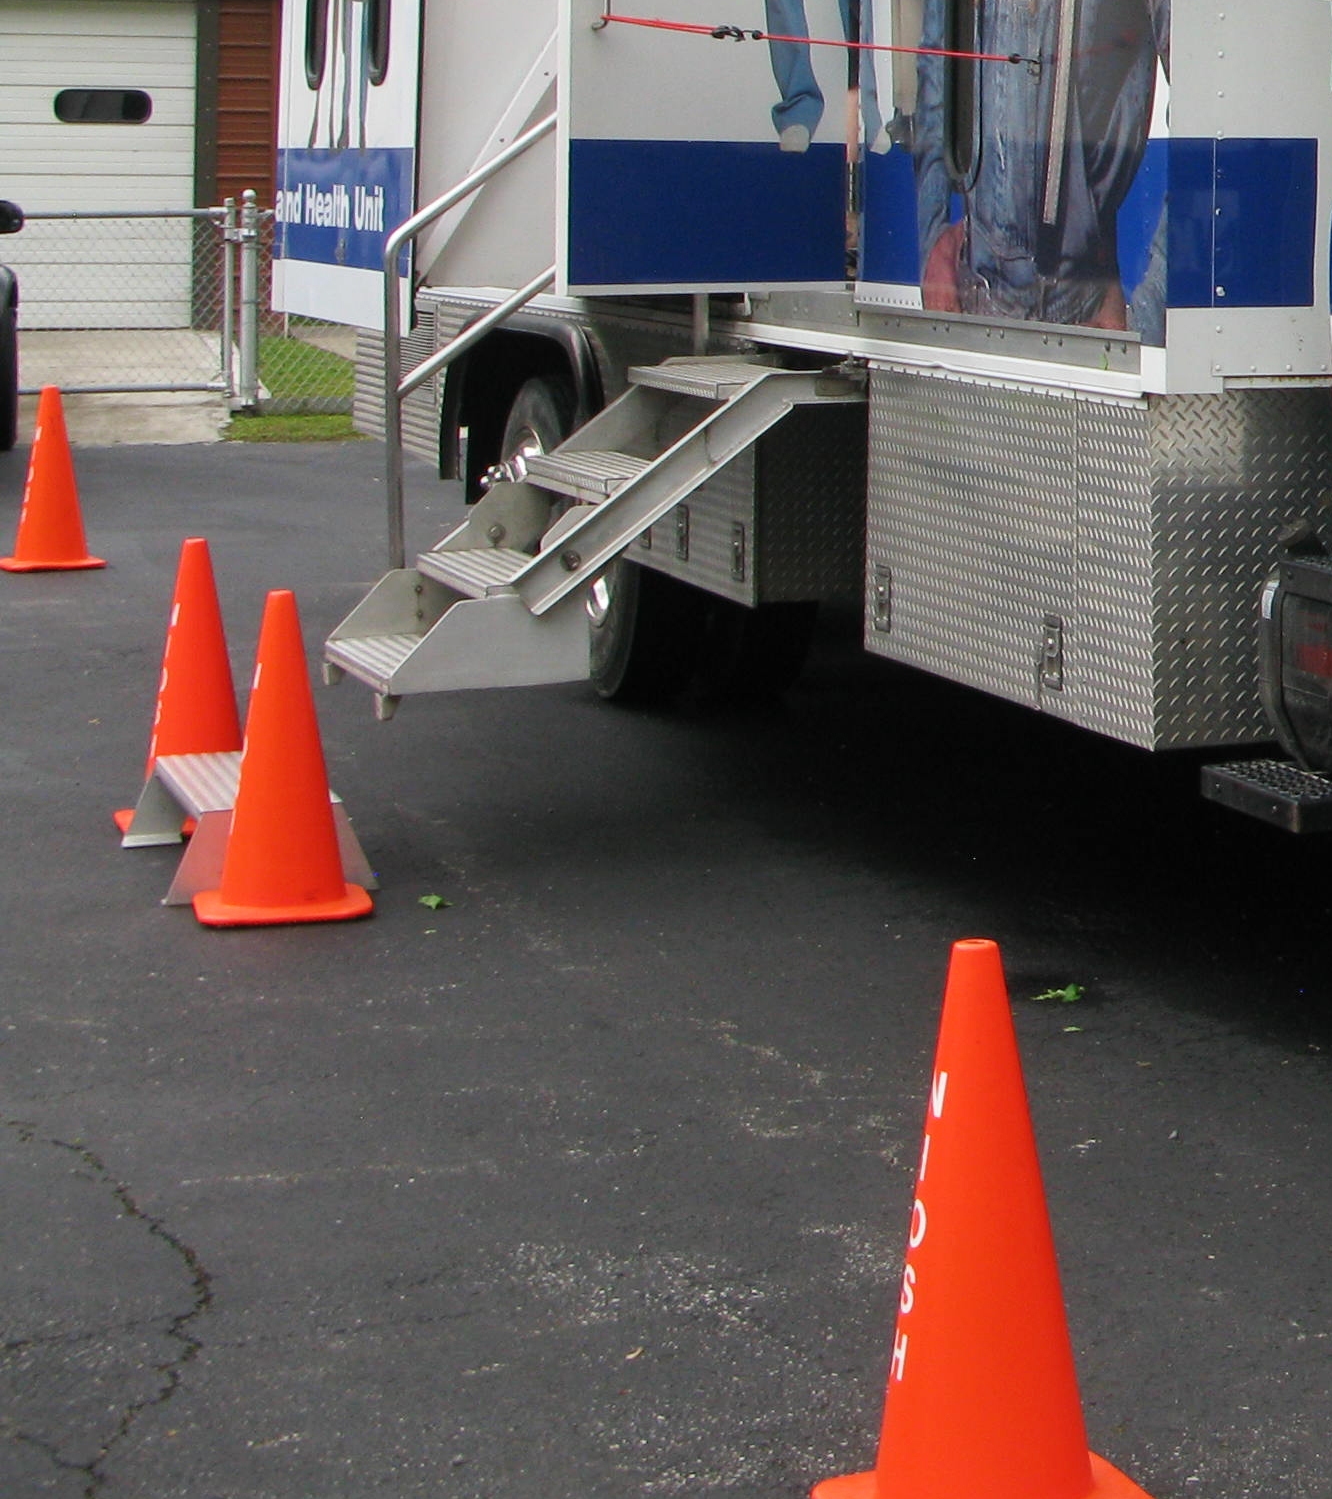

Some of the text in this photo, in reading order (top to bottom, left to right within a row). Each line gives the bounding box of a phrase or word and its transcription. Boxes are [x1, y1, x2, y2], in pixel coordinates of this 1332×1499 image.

[275, 182, 384, 233] and Health Unit
